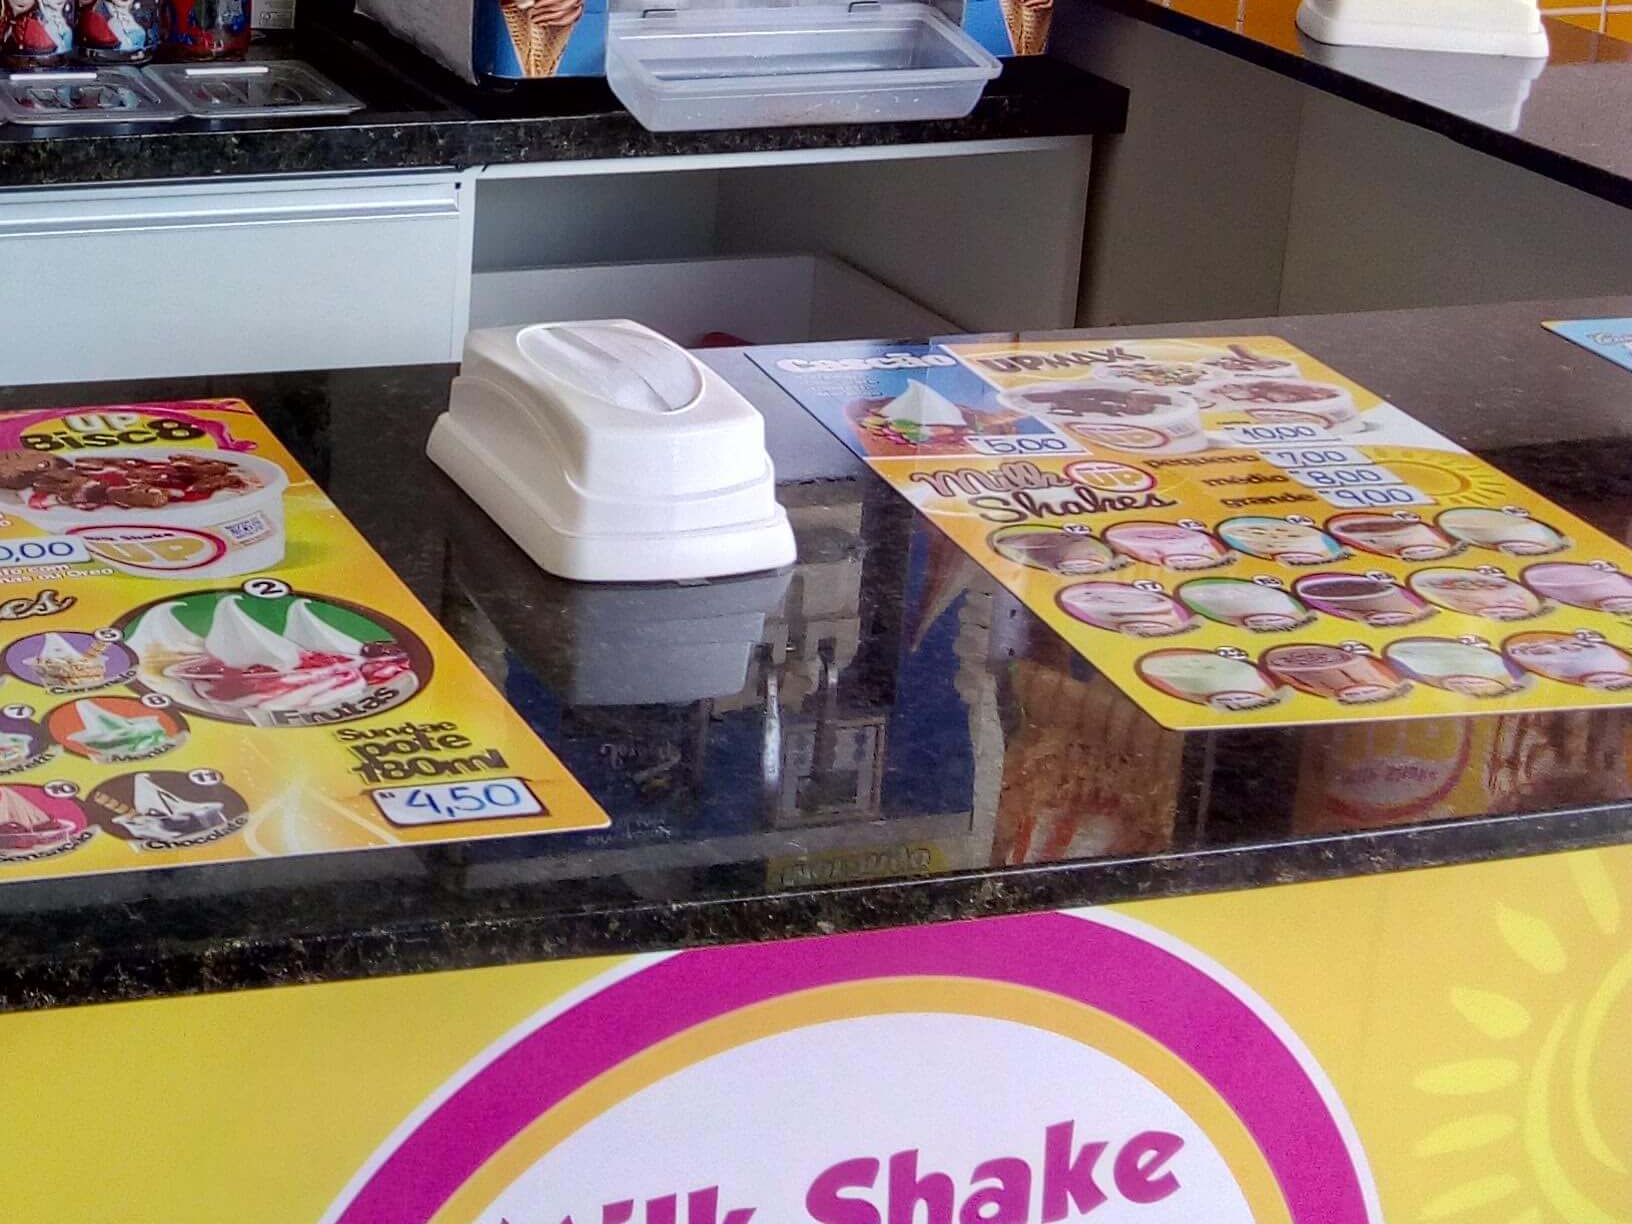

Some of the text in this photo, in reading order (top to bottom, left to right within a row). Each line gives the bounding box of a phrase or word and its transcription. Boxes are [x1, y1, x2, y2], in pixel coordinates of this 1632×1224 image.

[776, 352, 958, 372] Cascão
[63, 412, 138, 433] UP
[1242, 426, 1317, 440] 10,00
[984, 437, 1067, 454] 5,00
[1142, 453, 1261, 468] pequeno
[1277, 450, 1347, 467] 7,00
[909, 460, 1075, 497] Milk
[1202, 473, 1290, 486] médio
[1306, 469, 1383, 487] 8,00
[970, 485, 1178, 523] Shakes
[1220, 492, 1317, 507] grande
[1334, 488, 1414, 507] 9,00
[252, 581, 283, 596] 2
[272, 686, 400, 726] Frutas
[336, 721, 458, 742] Sundae
[349, 731, 473, 758] pote
[351, 748, 509, 784] 180ml
[191, 771, 219, 783] 11
[48, 783, 75, 795] 10
[406, 782, 521, 817] 4,50
[143, 817, 249, 851] Chocolate
[805, 1119, 1185, 1224] Shake
